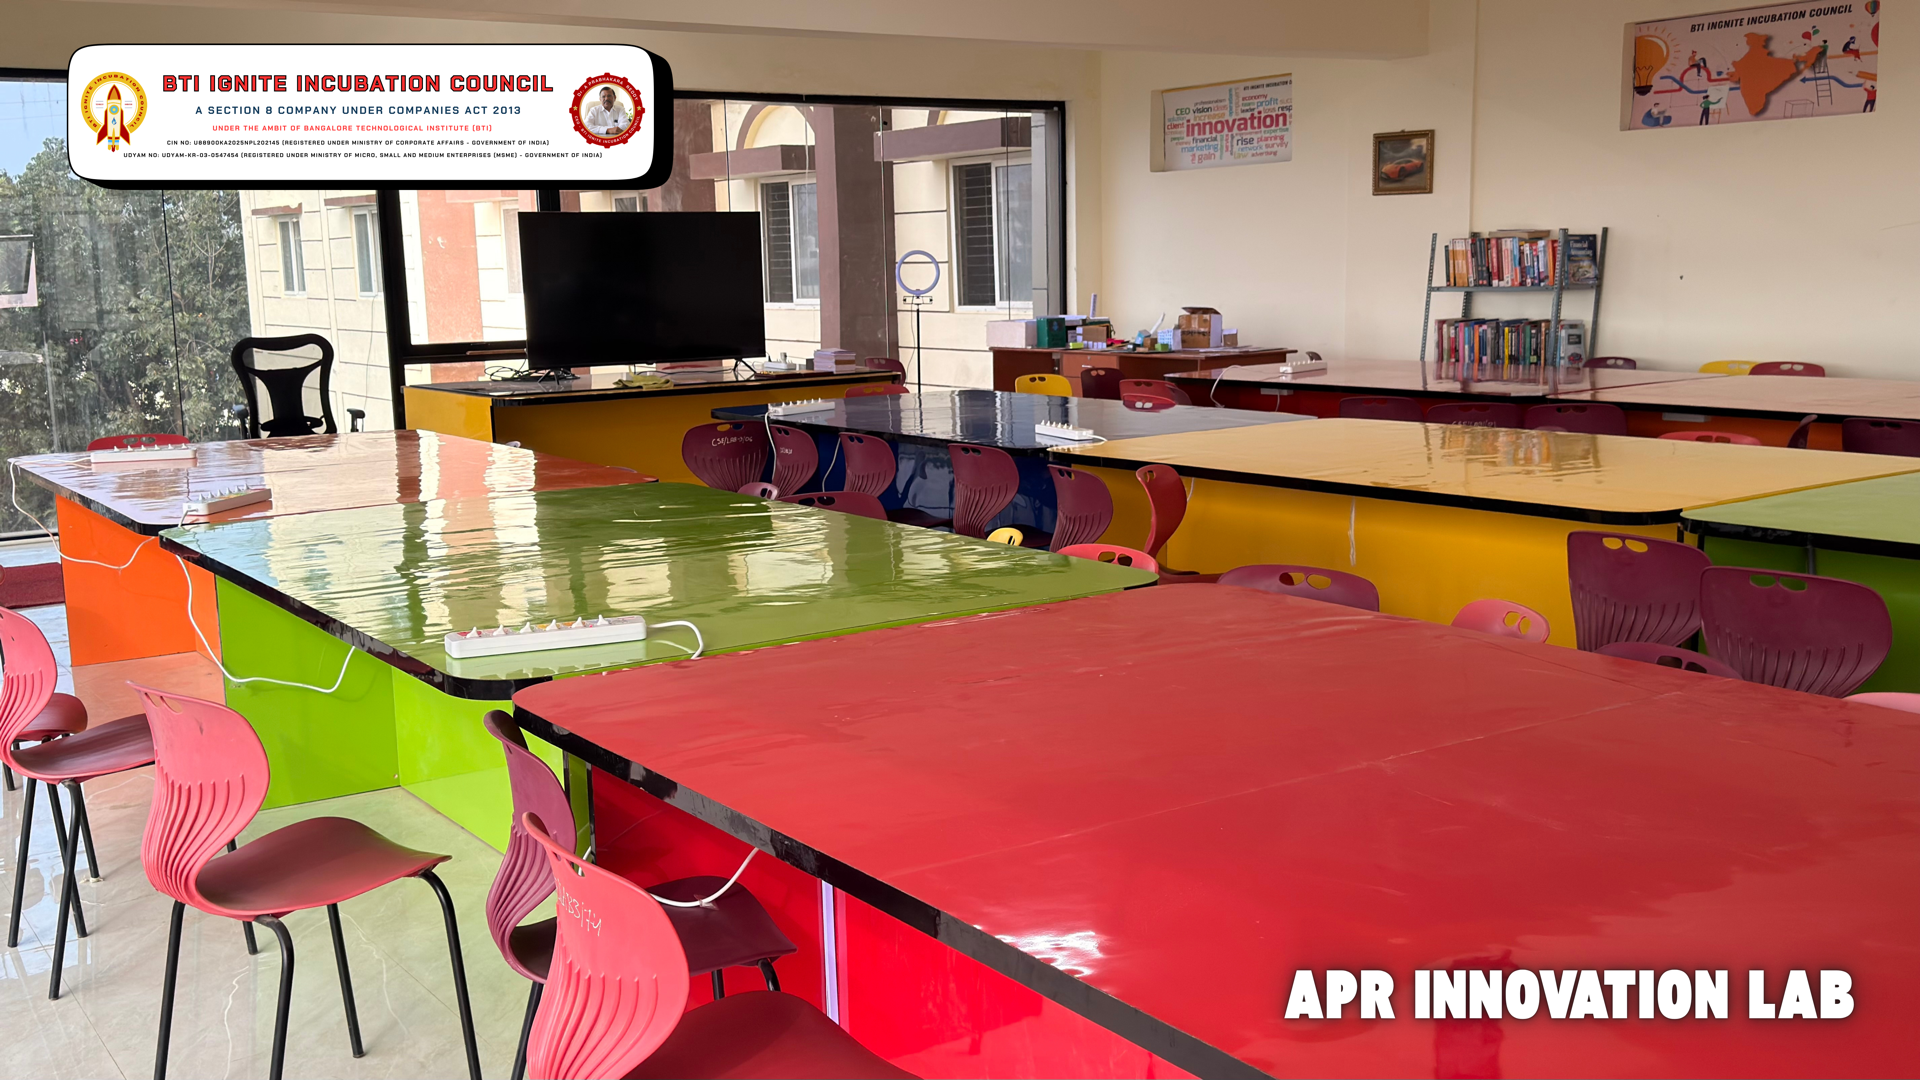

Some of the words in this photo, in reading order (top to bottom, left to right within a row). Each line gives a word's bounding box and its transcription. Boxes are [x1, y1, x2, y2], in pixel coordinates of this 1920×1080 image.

[1690, 23, 1705, 33] BTI
[1707, 17, 1745, 31] INGNITE
[1747, 10, 1806, 27] INCUBATION
[1809, 4, 1853, 18] COUNCIL
[1242, 93, 1268, 101] economy
[1256, 97, 1279, 109] profit
[1175, 107, 1190, 116] CEO
[1192, 106, 1212, 114] vision
[1241, 106, 1256, 114] leader
[1193, 112, 1225, 121] increase
[1166, 122, 1185, 130] client
[1186, 110, 1288, 138] innovation
[1263, 127, 1289, 135] expertise
[1192, 135, 1218, 144] financial
[1236, 137, 1255, 146] rise
[1257, 134, 1285, 145] planning
[1181, 143, 1219, 153] marketing
[1238, 144, 1263, 152] network
[1265, 141, 1289, 149] survey
[1197, 152, 1216, 164] gain
